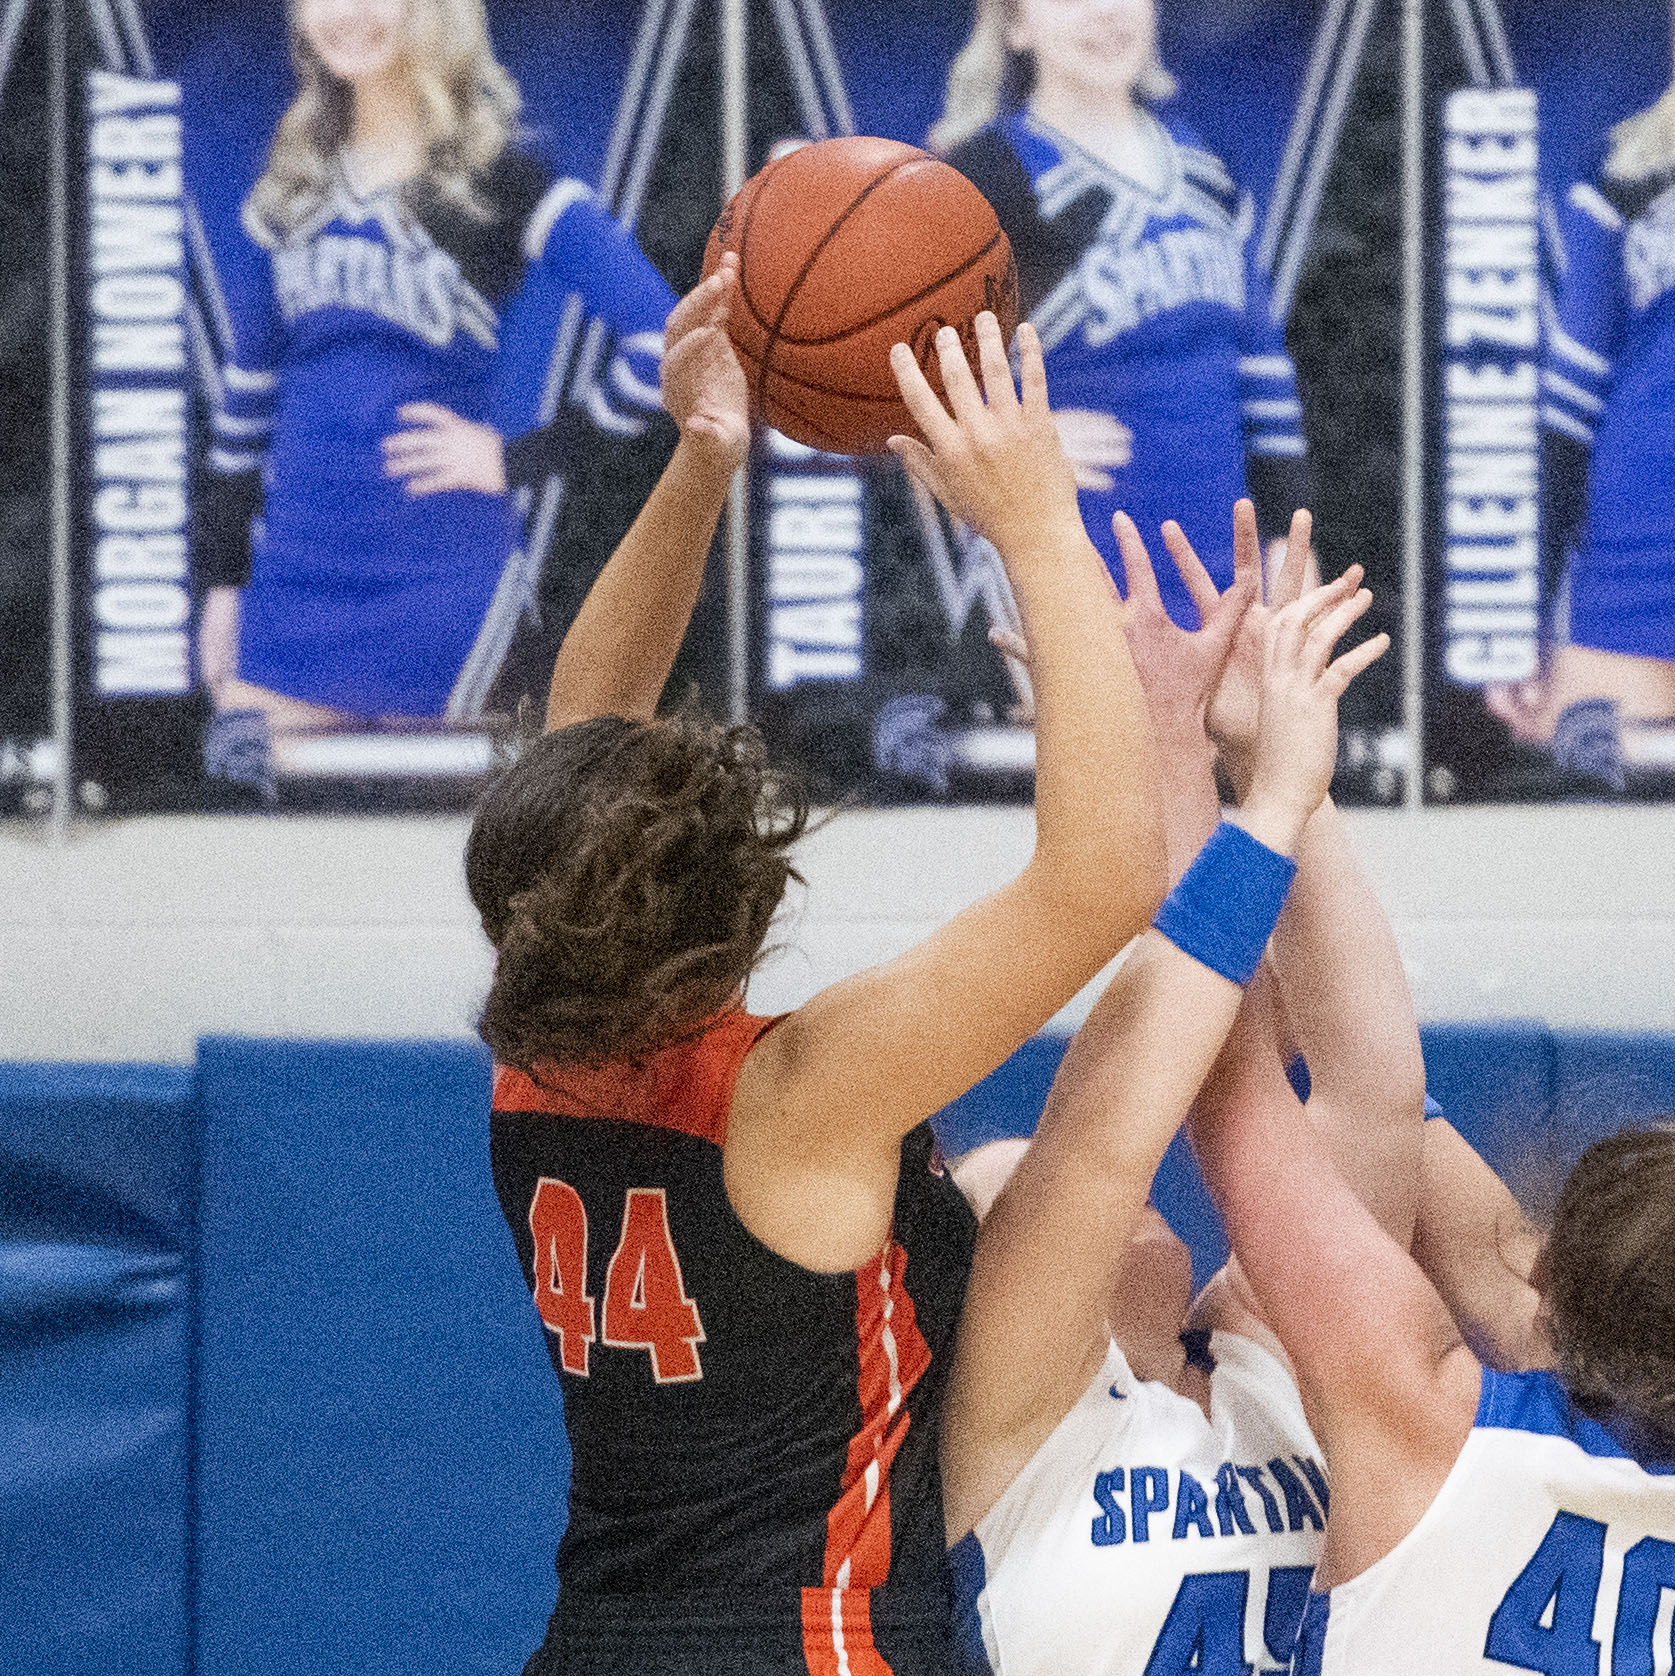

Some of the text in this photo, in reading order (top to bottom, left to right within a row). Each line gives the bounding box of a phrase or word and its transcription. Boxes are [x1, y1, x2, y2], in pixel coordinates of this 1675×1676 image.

[1443, 87, 1539, 347] ZENKER
[89, 72, 190, 694] MORGAN NOWERY
[768, 475, 864, 688] TAURI
[529, 1176, 706, 1384] 44
